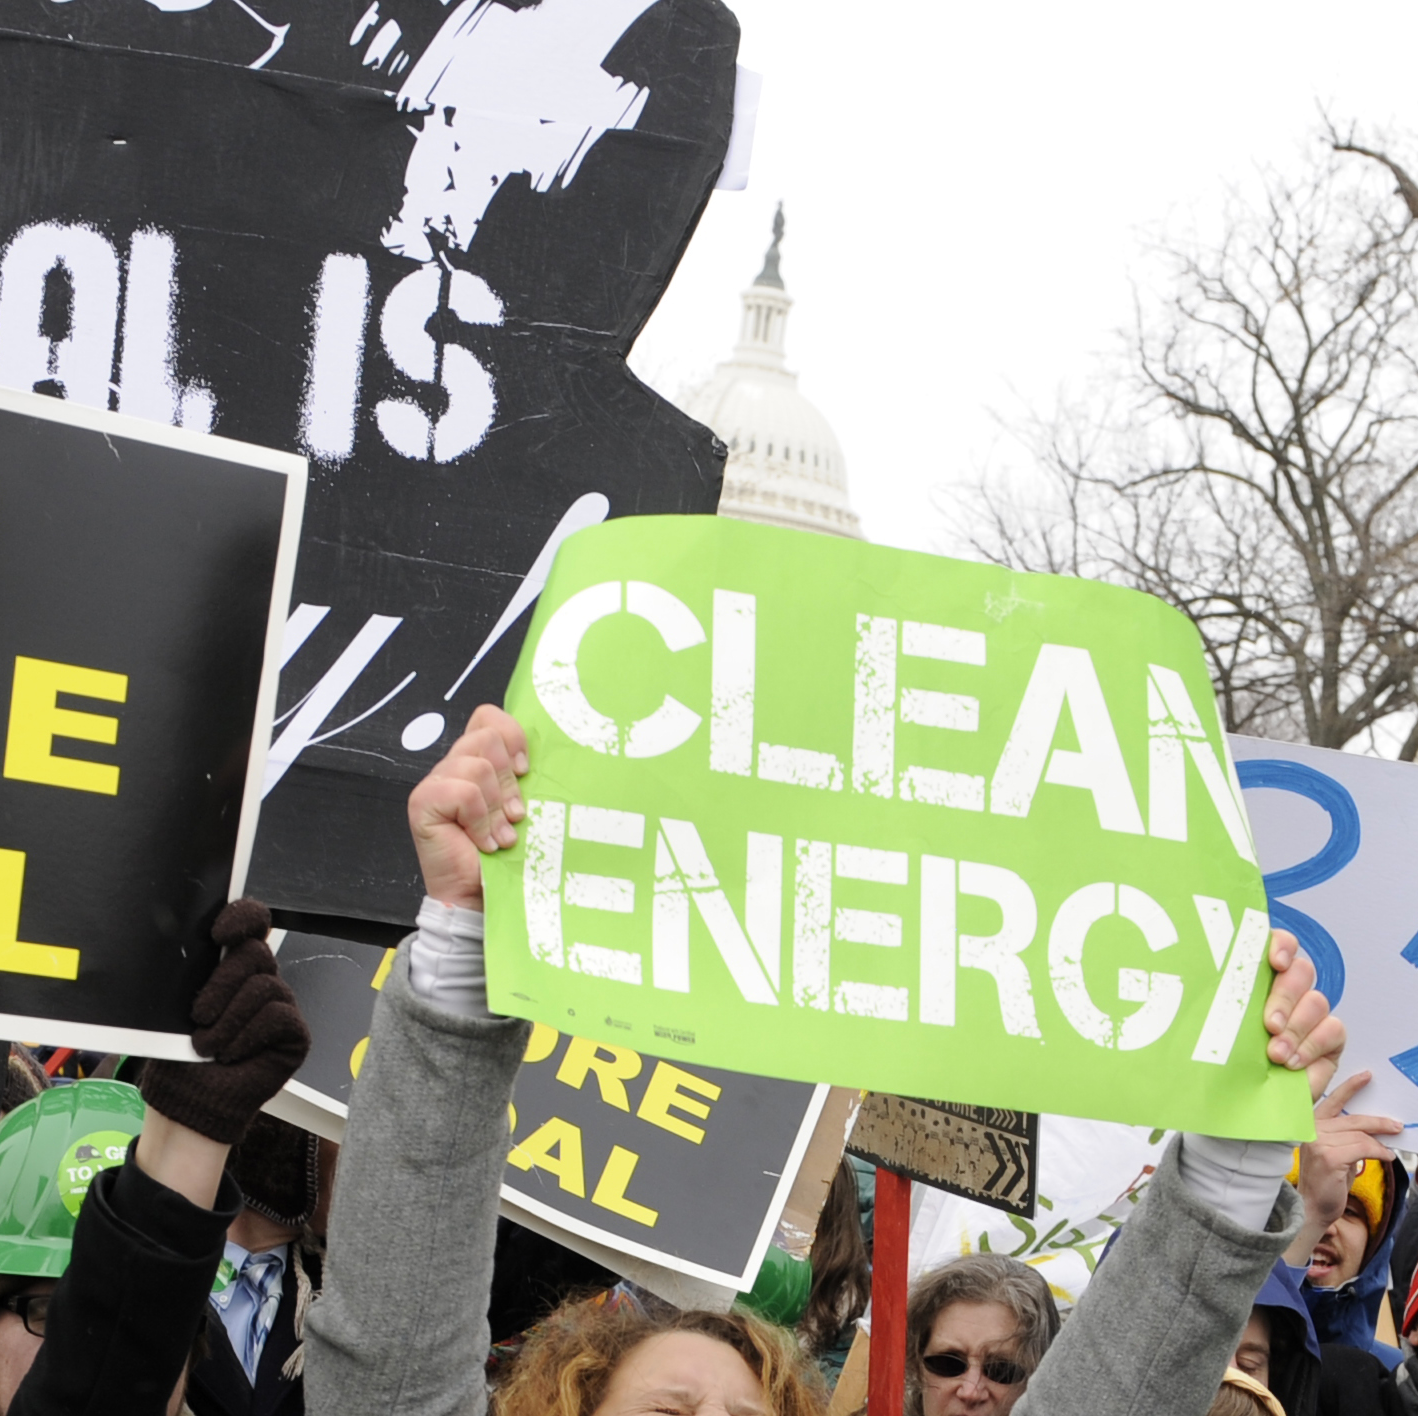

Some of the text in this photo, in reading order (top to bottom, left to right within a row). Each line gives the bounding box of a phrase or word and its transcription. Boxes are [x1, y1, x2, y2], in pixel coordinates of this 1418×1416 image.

[301, 252, 506, 466] IS
[531, 580, 1258, 867] CLEAN
[523, 800, 1269, 1066] ENERGY
[66, 1165, 92, 1183] TO
